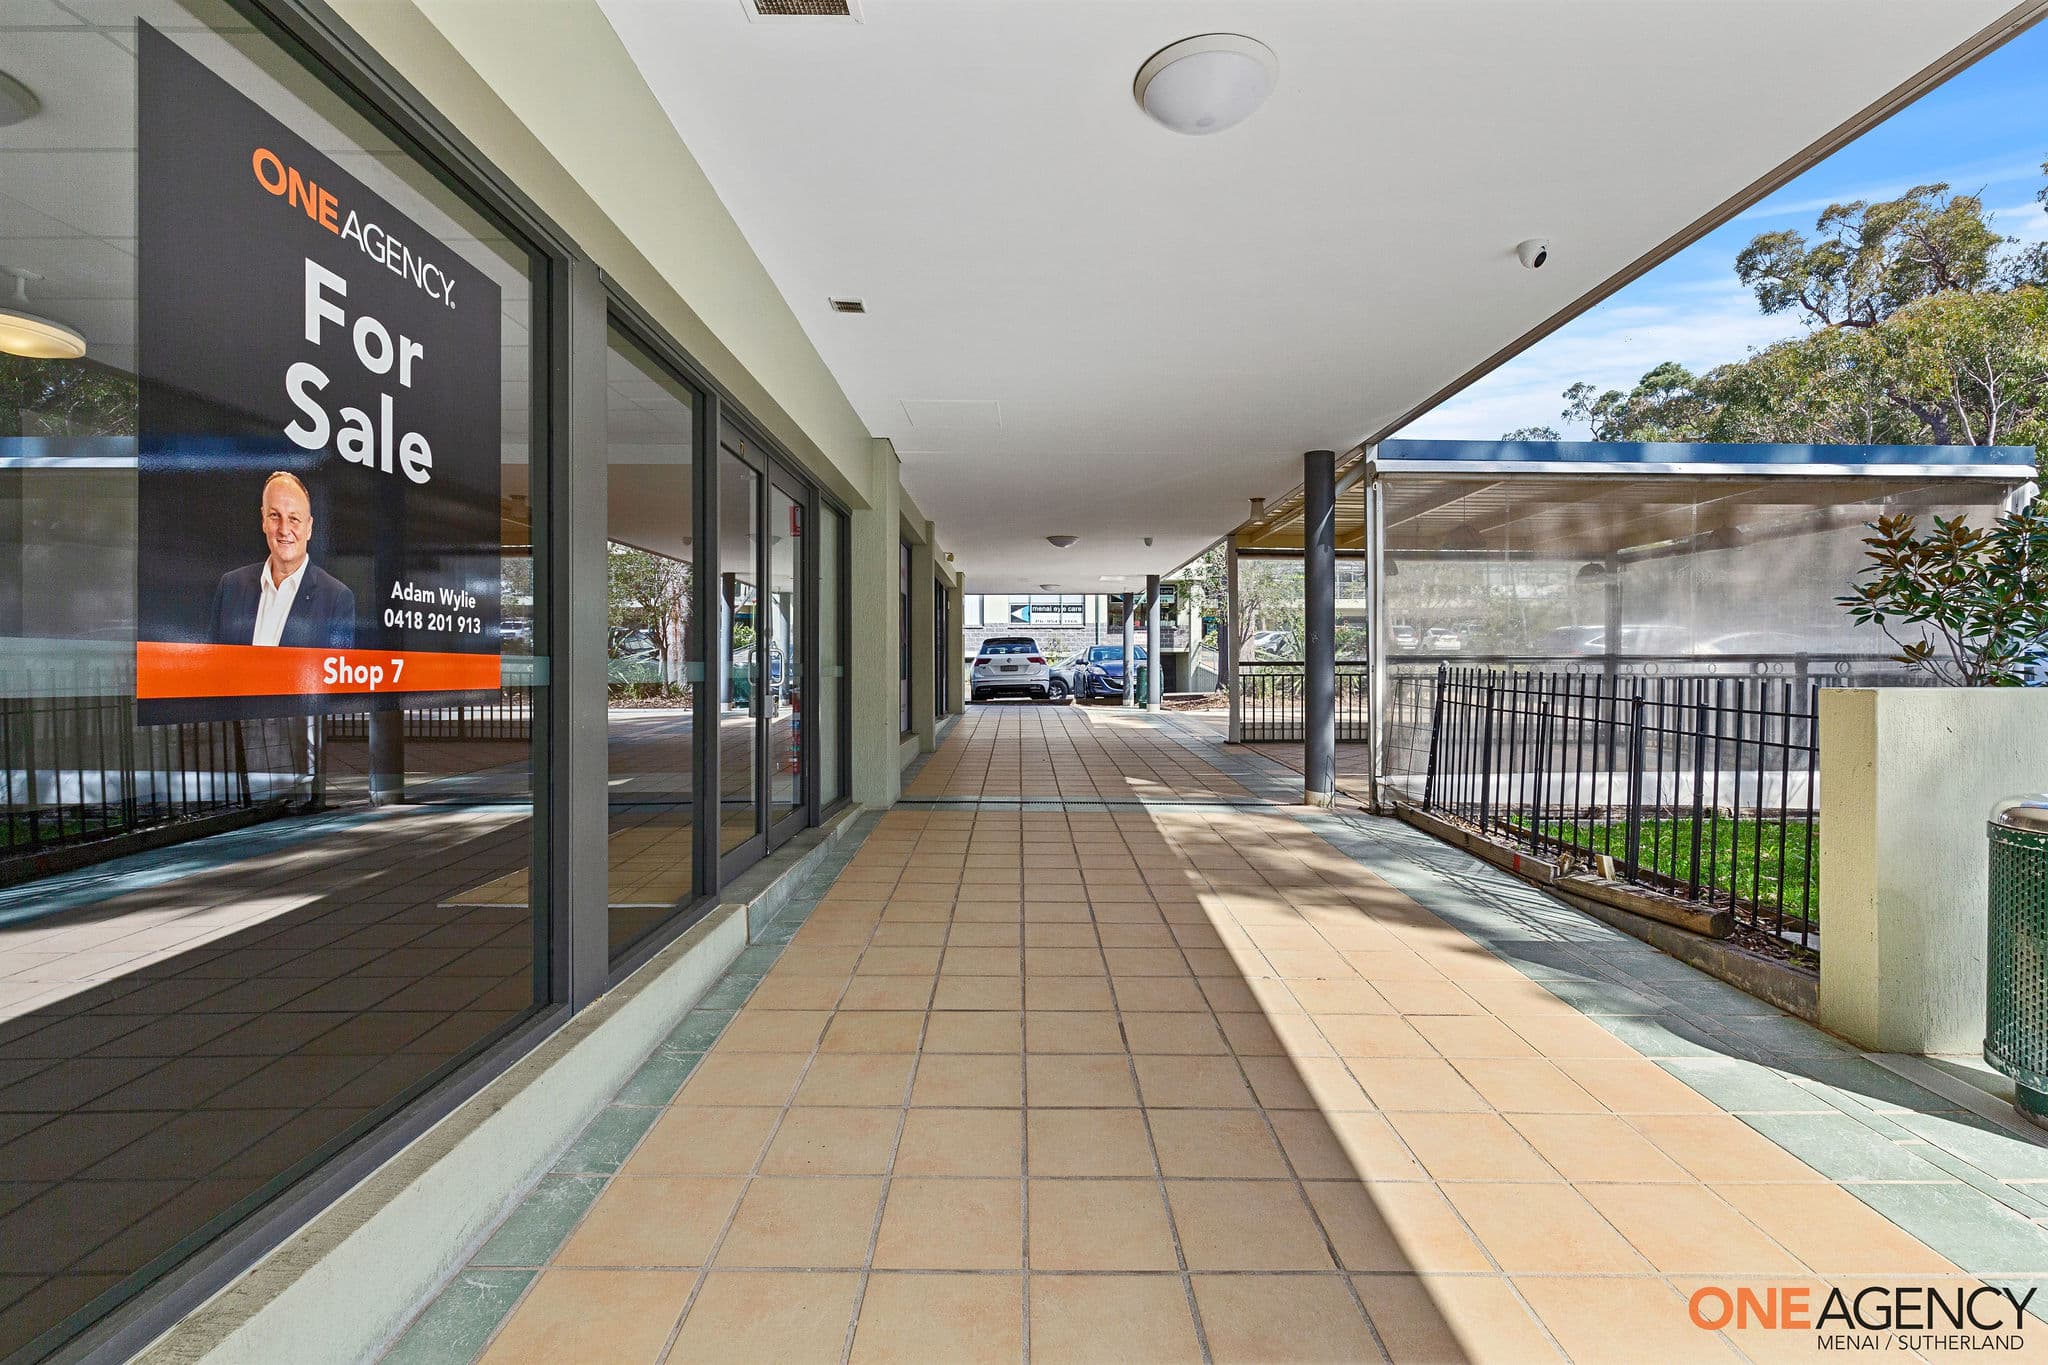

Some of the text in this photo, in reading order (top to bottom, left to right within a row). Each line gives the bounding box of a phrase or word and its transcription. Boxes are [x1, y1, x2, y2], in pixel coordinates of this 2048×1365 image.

[305, 257, 423, 388] For
[283, 361, 433, 484] Sale
[391, 580, 477, 612] Adam Wylie
[384, 608, 481, 634] 0418 201 913
[323, 655, 404, 691] Shop 7
